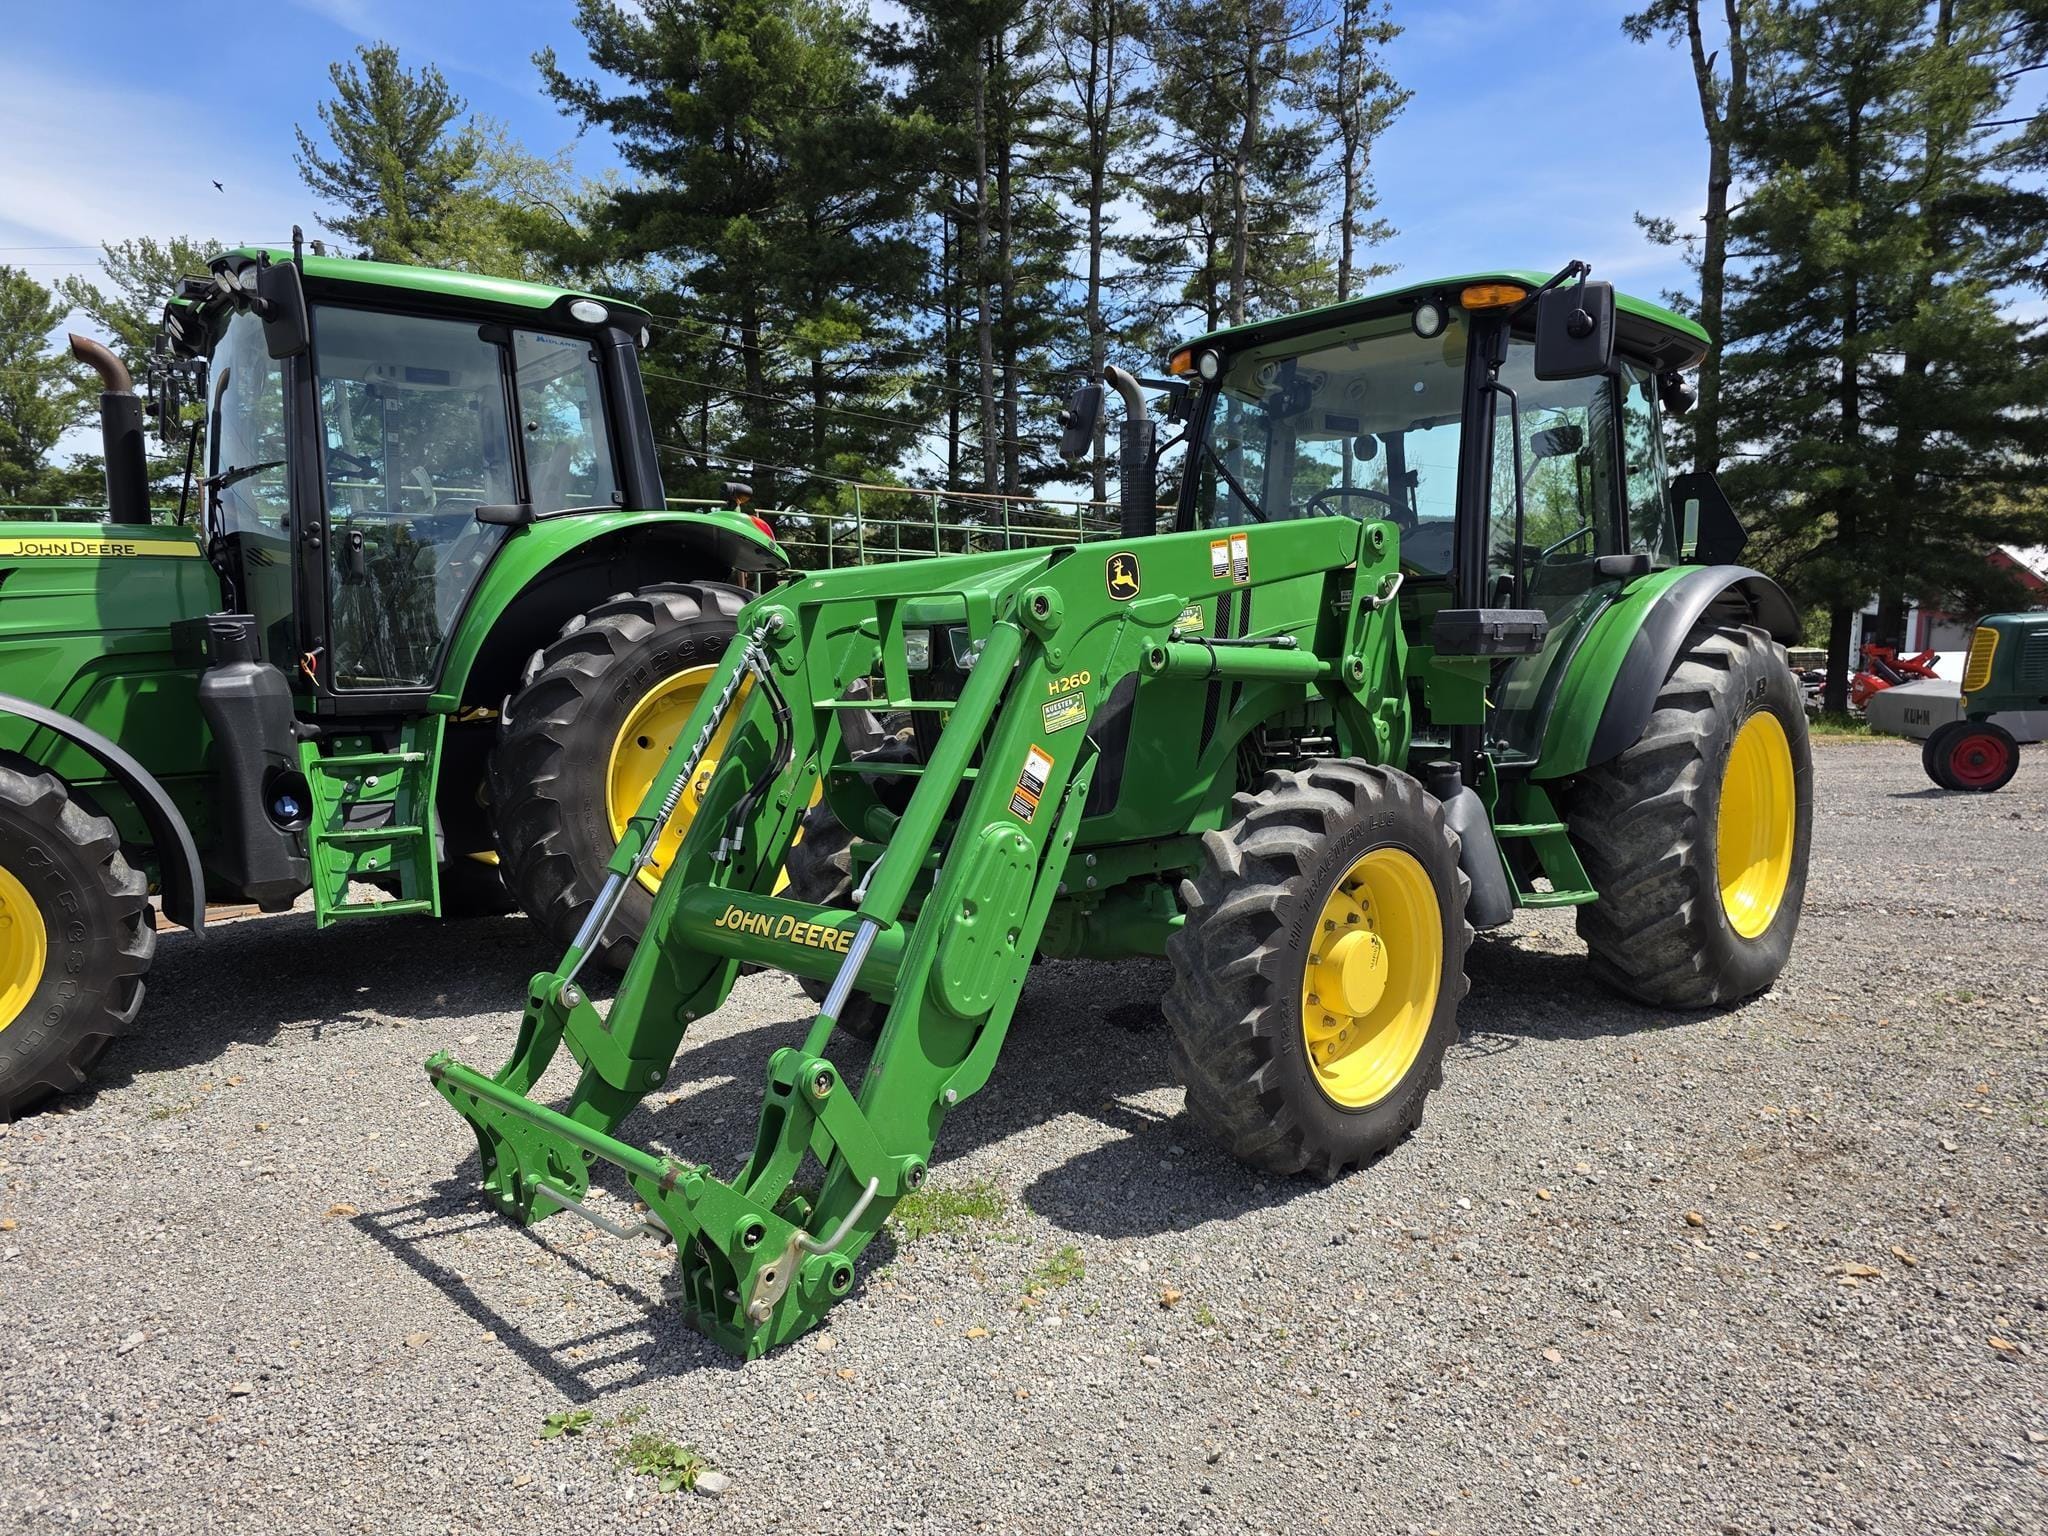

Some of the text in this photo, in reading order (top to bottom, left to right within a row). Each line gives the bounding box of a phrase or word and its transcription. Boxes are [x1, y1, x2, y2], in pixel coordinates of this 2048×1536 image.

[536, 335, 577, 348] MIDLAND
[13, 541, 136, 555] JOHN DEERE
[1048, 671, 1091, 696] H260
[1045, 699, 1073, 714] KUESTER
[1903, 707, 1930, 725] KUHN
[1368, 811, 1396, 832] LUG
[715, 904, 856, 954] JOHN DEERE
